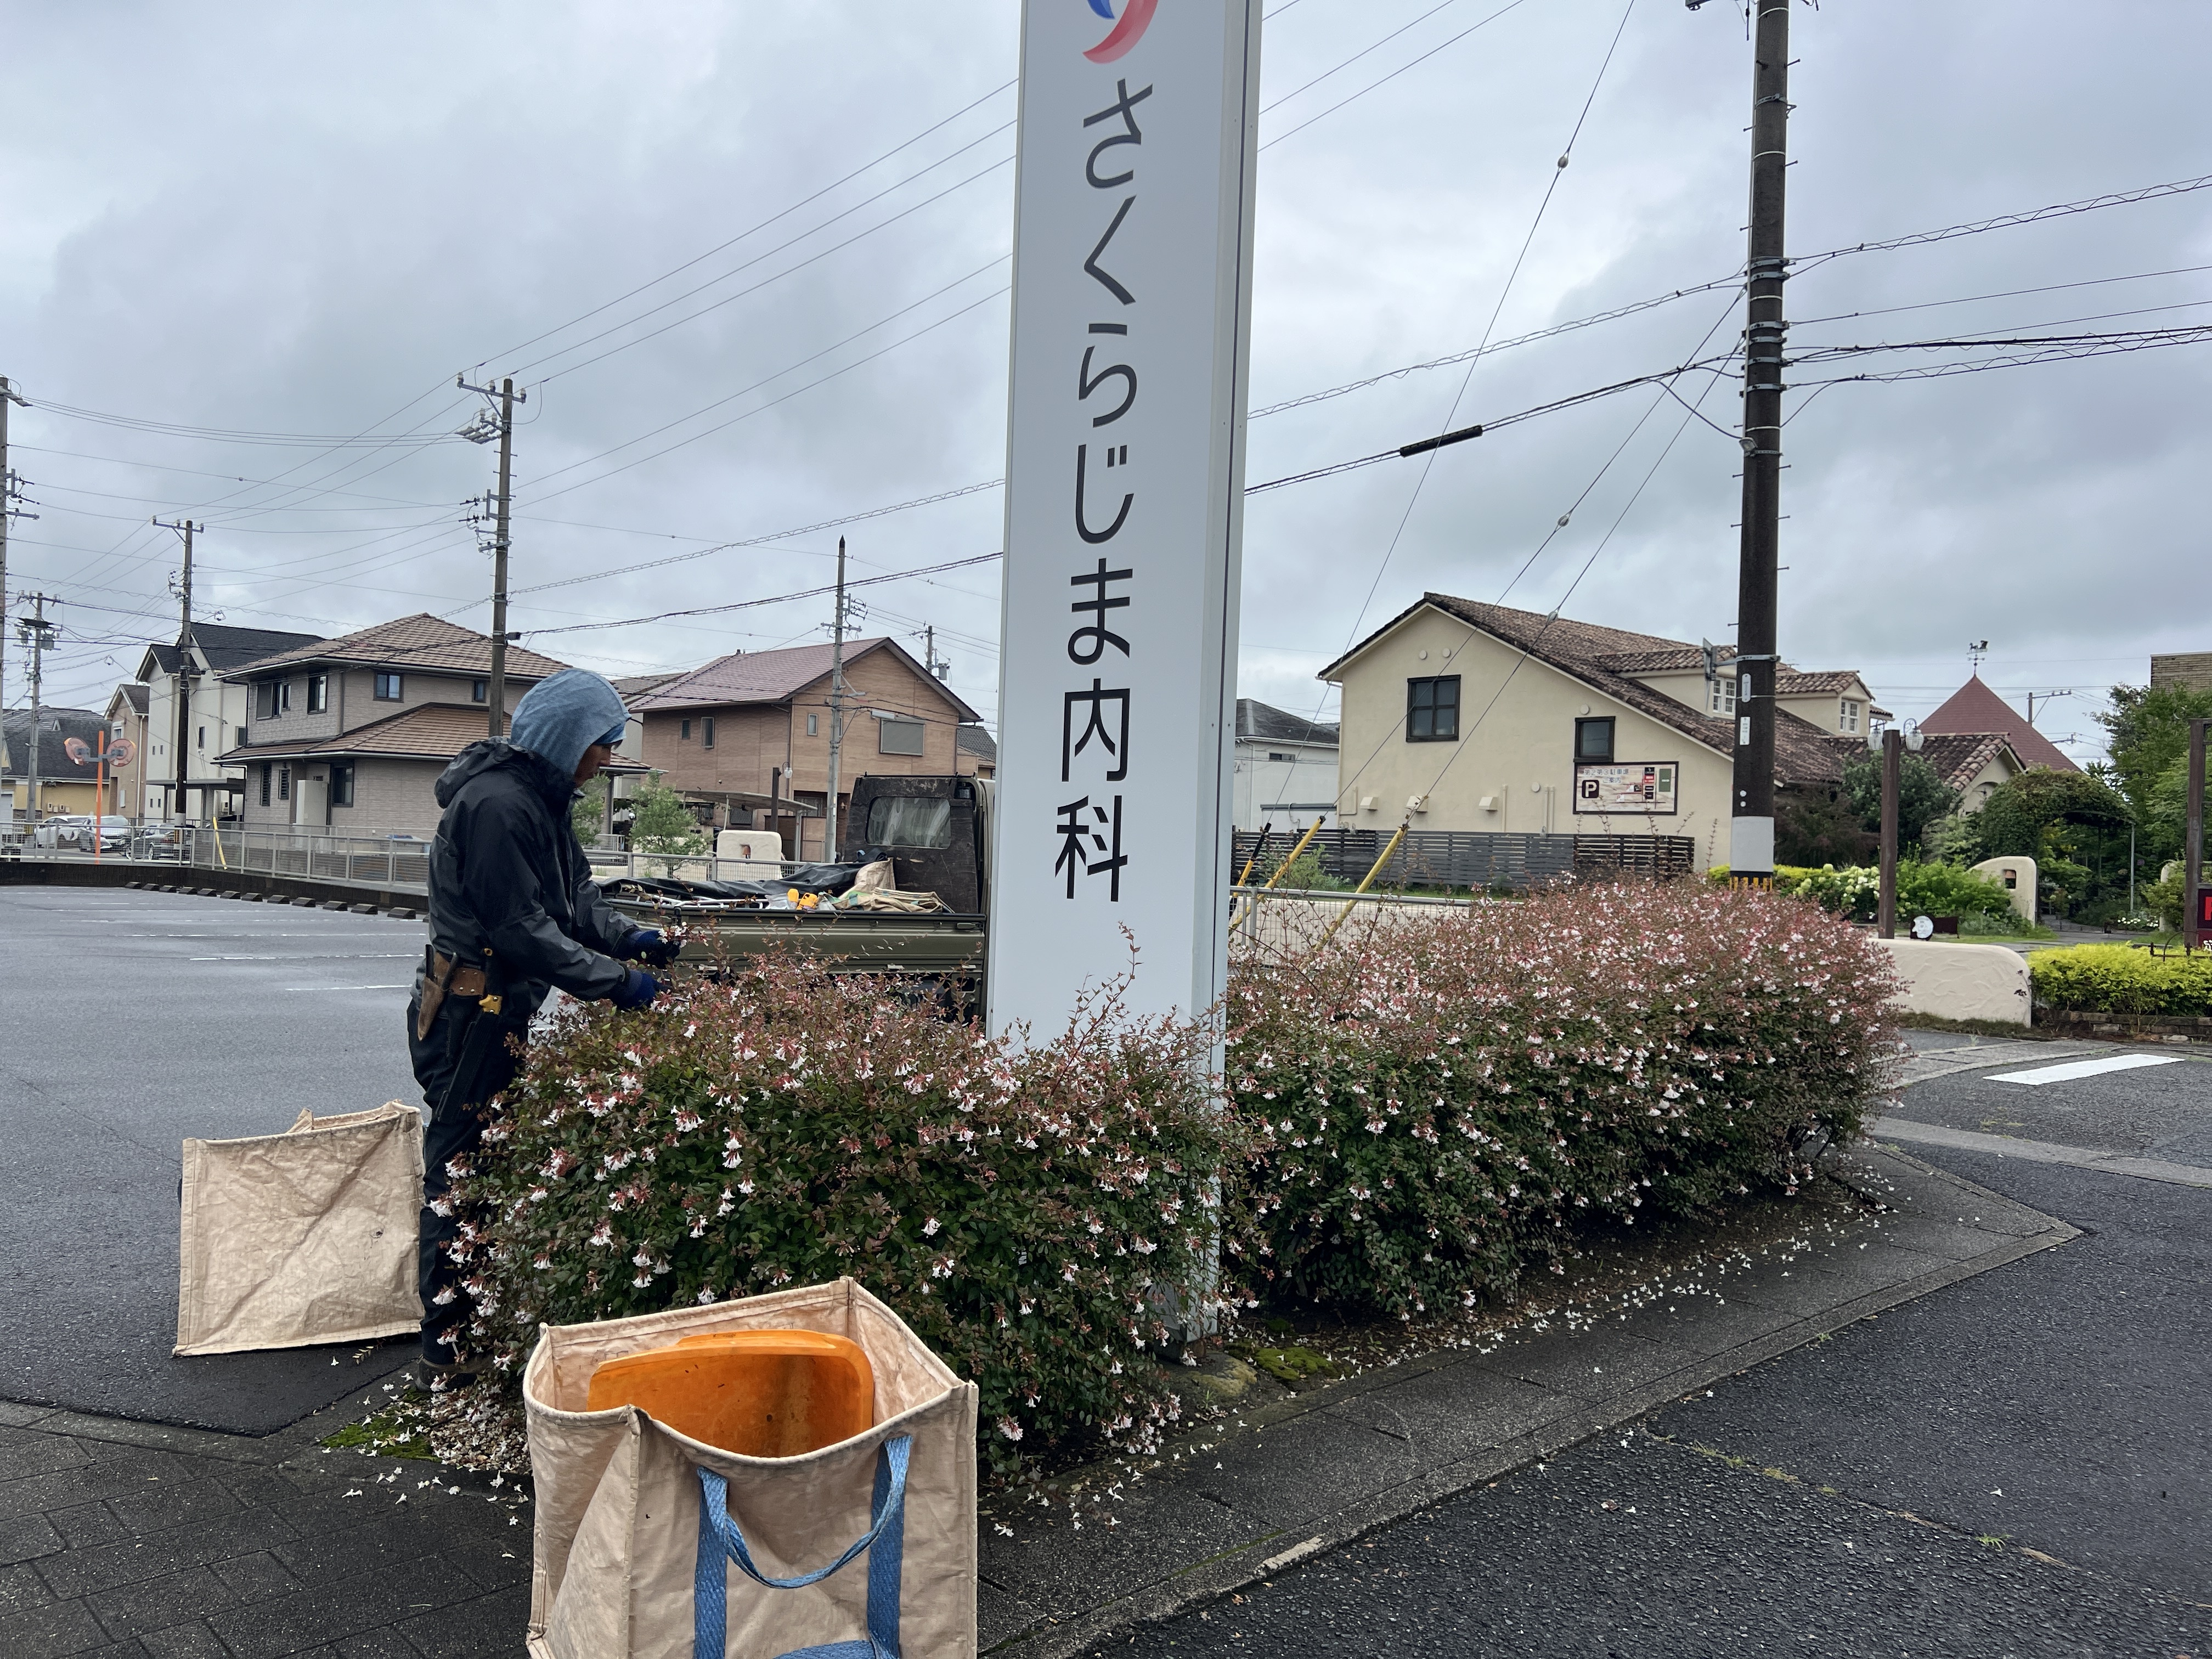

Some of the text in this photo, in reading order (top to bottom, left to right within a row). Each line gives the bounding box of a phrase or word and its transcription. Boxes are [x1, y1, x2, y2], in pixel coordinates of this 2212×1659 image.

[1056, 79, 1152, 902] さくらじま内科
[1585, 782, 1596, 798] P
